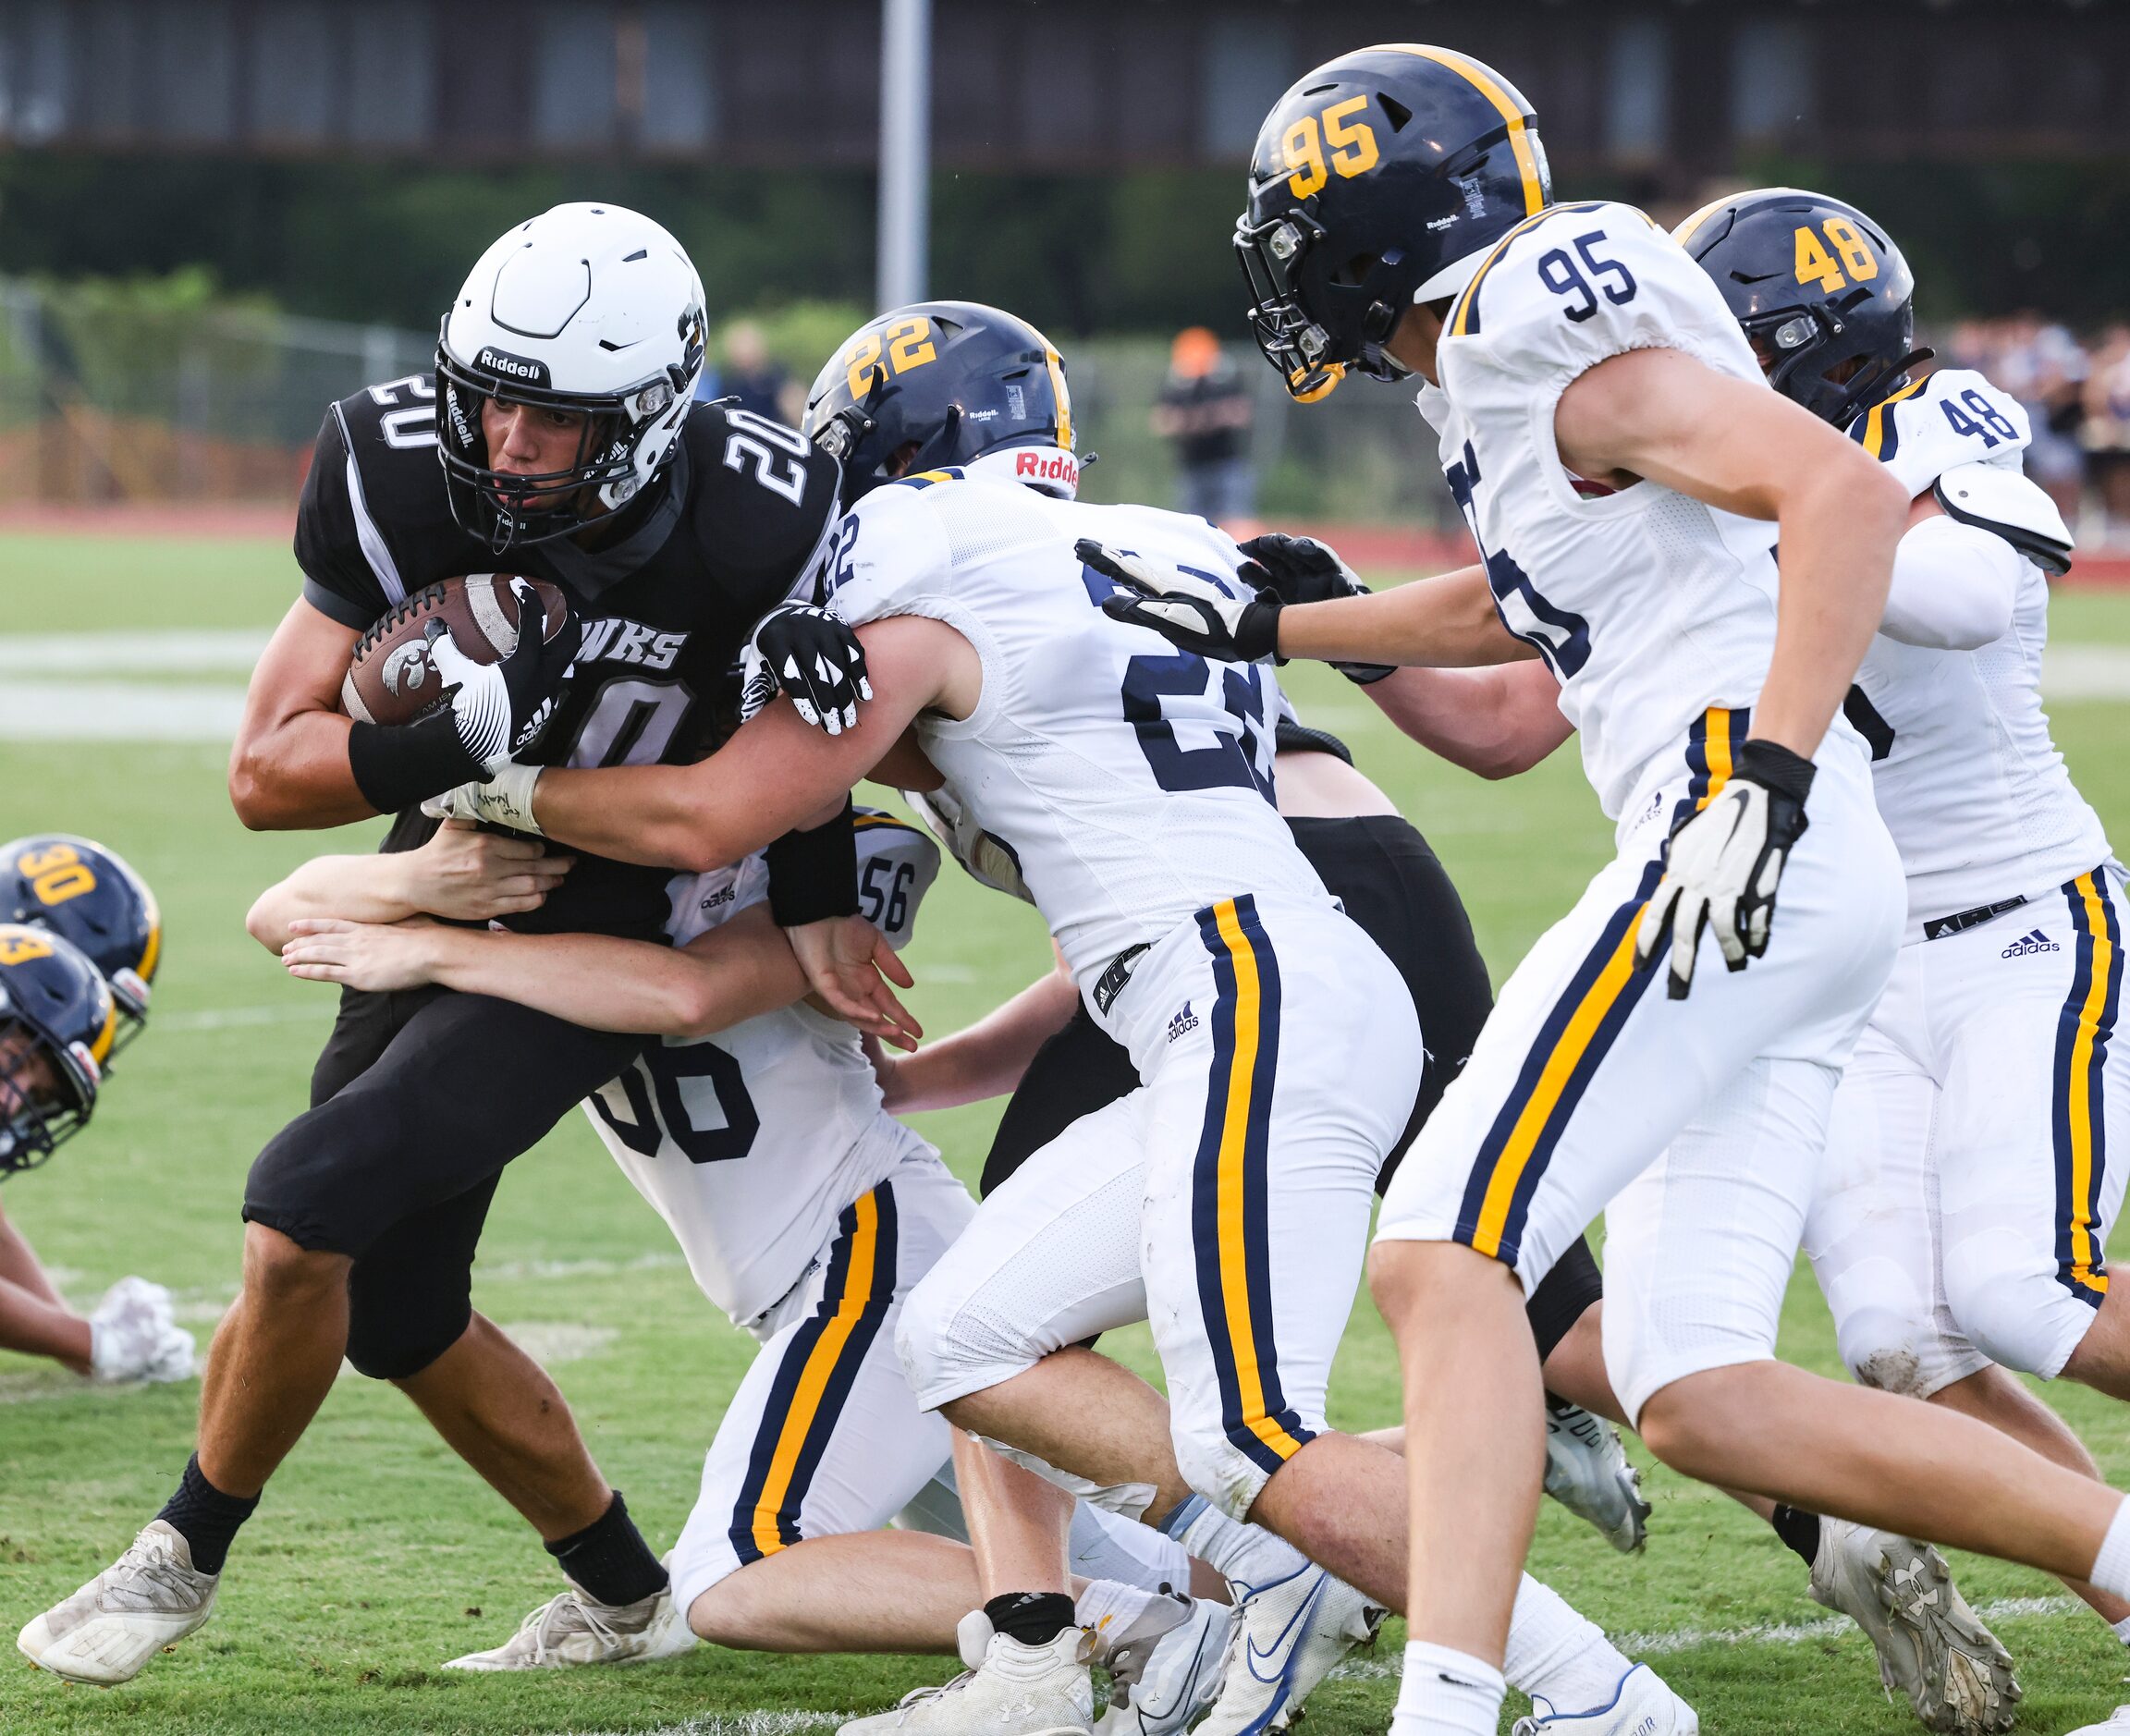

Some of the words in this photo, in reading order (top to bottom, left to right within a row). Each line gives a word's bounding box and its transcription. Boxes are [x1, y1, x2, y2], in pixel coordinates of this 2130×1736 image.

[1282, 94, 1379, 200] 95
[1538, 230, 1636, 323] 95
[1794, 217, 1879, 294] 48
[481, 350, 539, 380] Riddell
[845, 317, 936, 401] 22
[367, 375, 437, 449] 20
[447, 389, 474, 448] Riddell
[970, 409, 998, 420] Riddell
[1940, 389, 2019, 449] 48
[723, 409, 812, 508] 20
[1016, 452, 1079, 488] Ridde
[573, 618, 690, 670] WKS
[564, 679, 693, 769] 0
[18, 843, 96, 906] 30
[861, 857, 915, 934] 56
[2001, 942, 2061, 960] adidas
[1168, 1016, 1200, 1044] adidas
